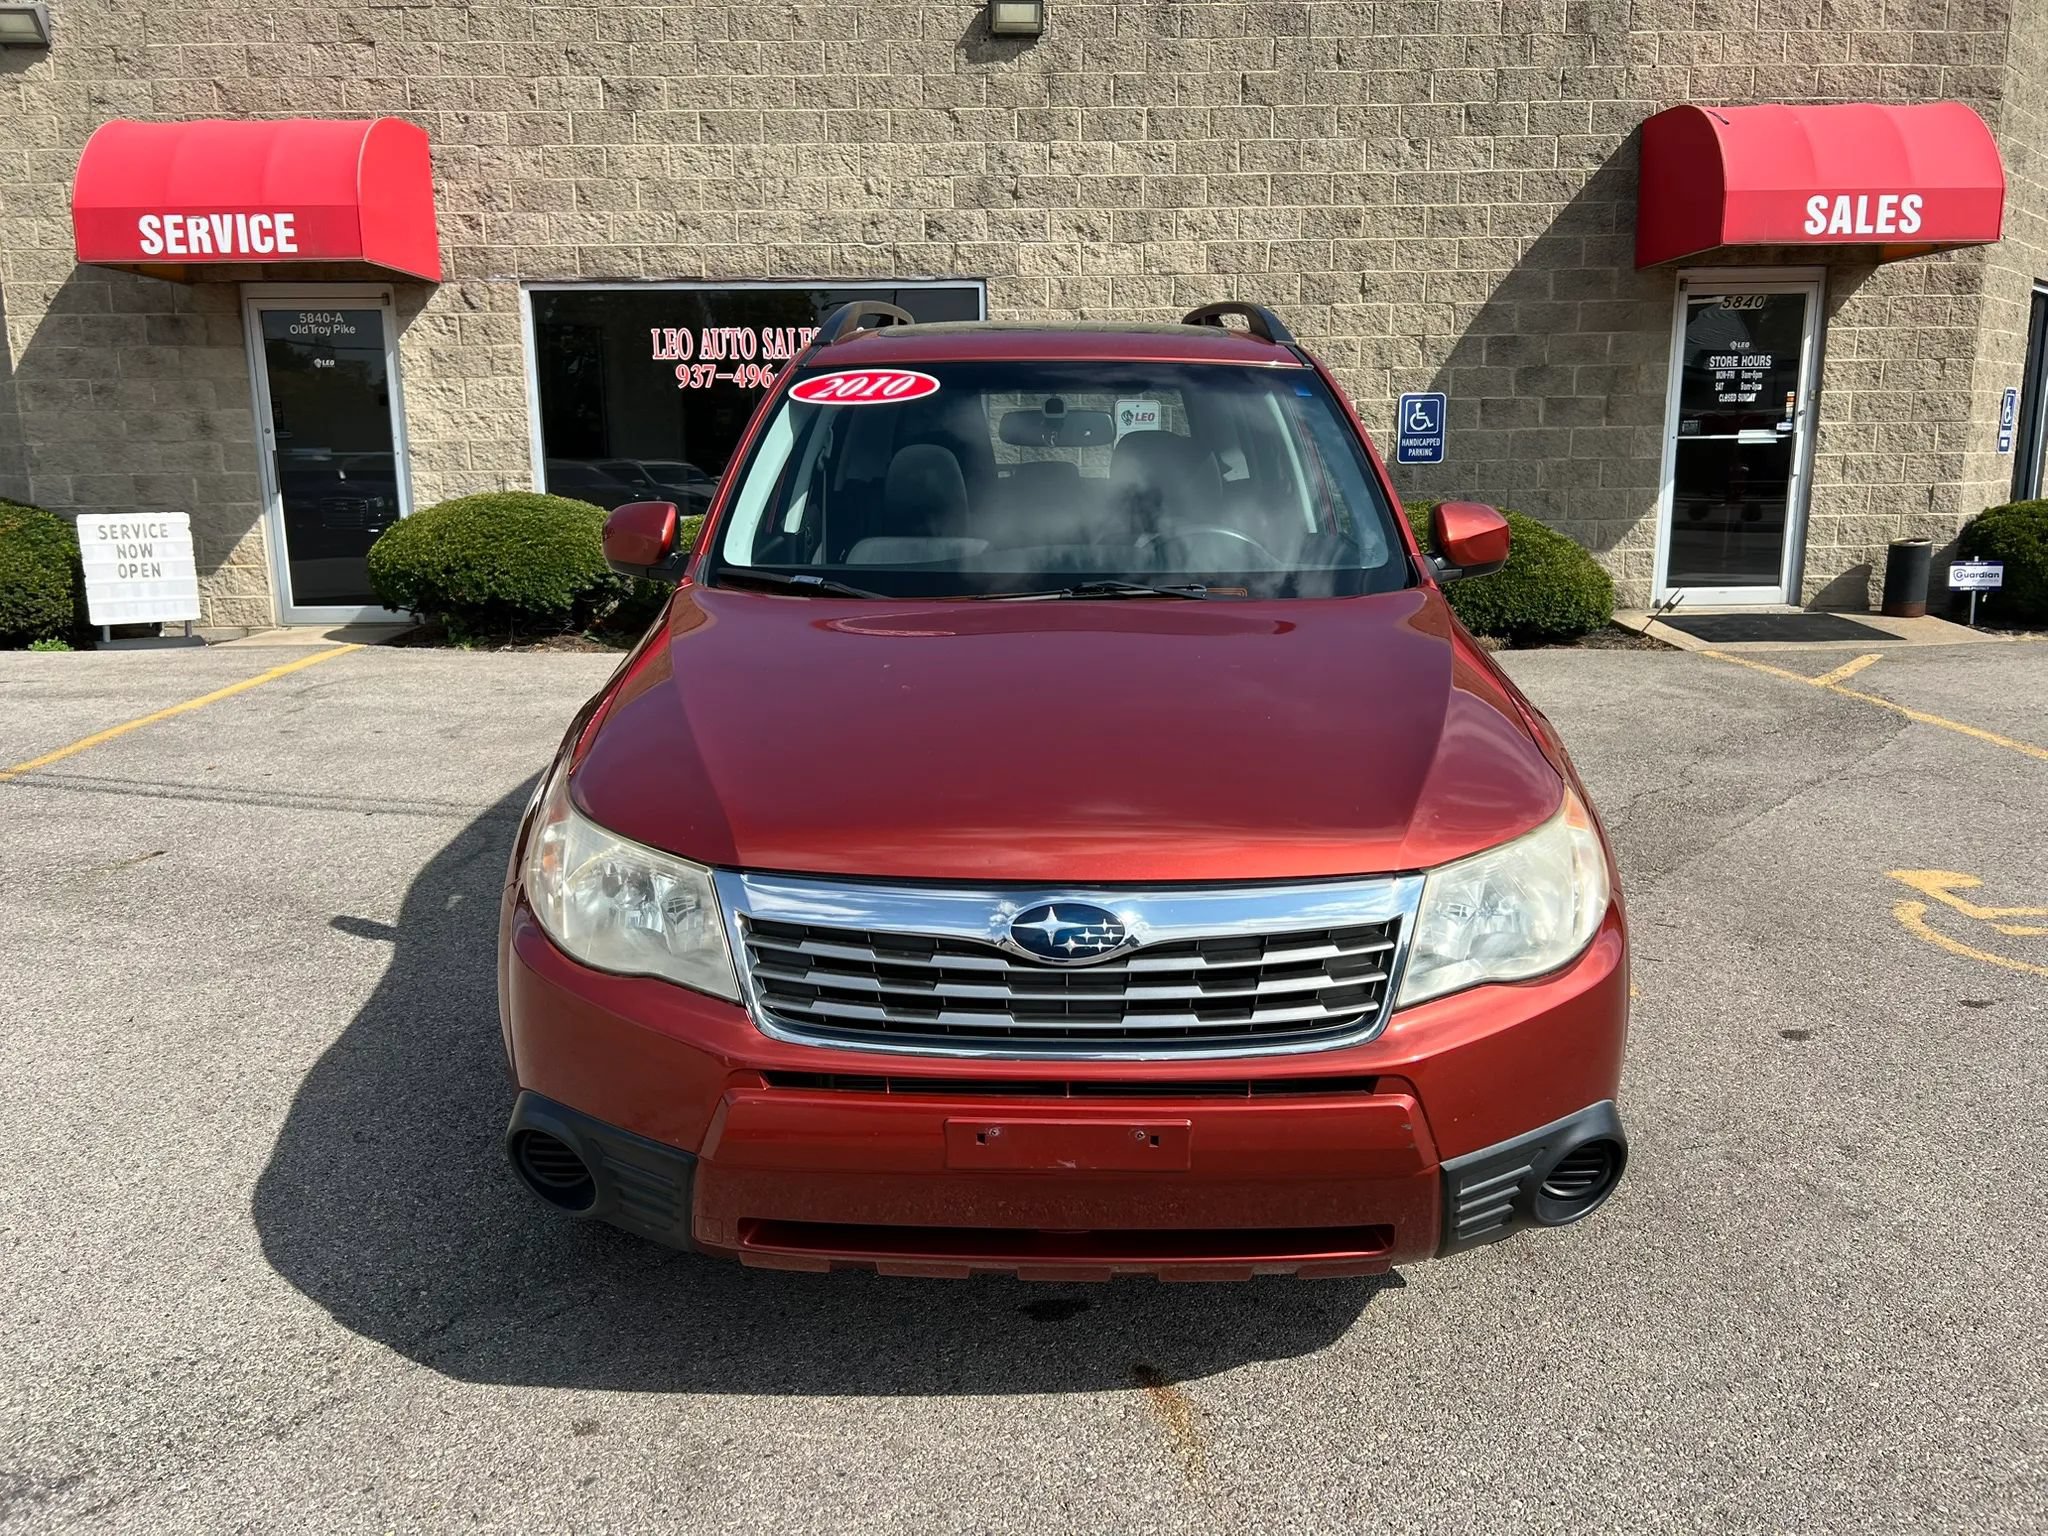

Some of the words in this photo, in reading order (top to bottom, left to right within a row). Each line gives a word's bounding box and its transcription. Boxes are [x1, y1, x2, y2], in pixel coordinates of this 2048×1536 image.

[1804, 194, 1923, 235] SALES
[138, 213, 298, 255] SERVICE
[1721, 295, 1765, 309] 5840
[300, 312, 344, 323] 5840-A
[290, 324, 309, 334] Old
[309, 324, 331, 336] Troy
[333, 324, 356, 334] Pike
[651, 328, 694, 360] LEO
[700, 327, 757, 360] AUTO
[1709, 356, 1738, 367] STORE
[1741, 355, 1772, 366] HOURS
[675, 363, 779, 389] 937-496
[808, 375, 917, 399] 2010
[1715, 382, 1725, 391] SAT
[1719, 393, 1737, 402] CLOSED
[1738, 393, 1757, 402] SUNDAY
[1135, 412, 1155, 422] LEO
[1401, 437, 1441, 447] HANDICAPPED
[1408, 448, 1433, 457] PARKING
[97, 522, 169, 540] SERVICE
[116, 543, 153, 559] NOW
[117, 562, 162, 579] OPEN
[1953, 570, 2000, 581] Guardian
